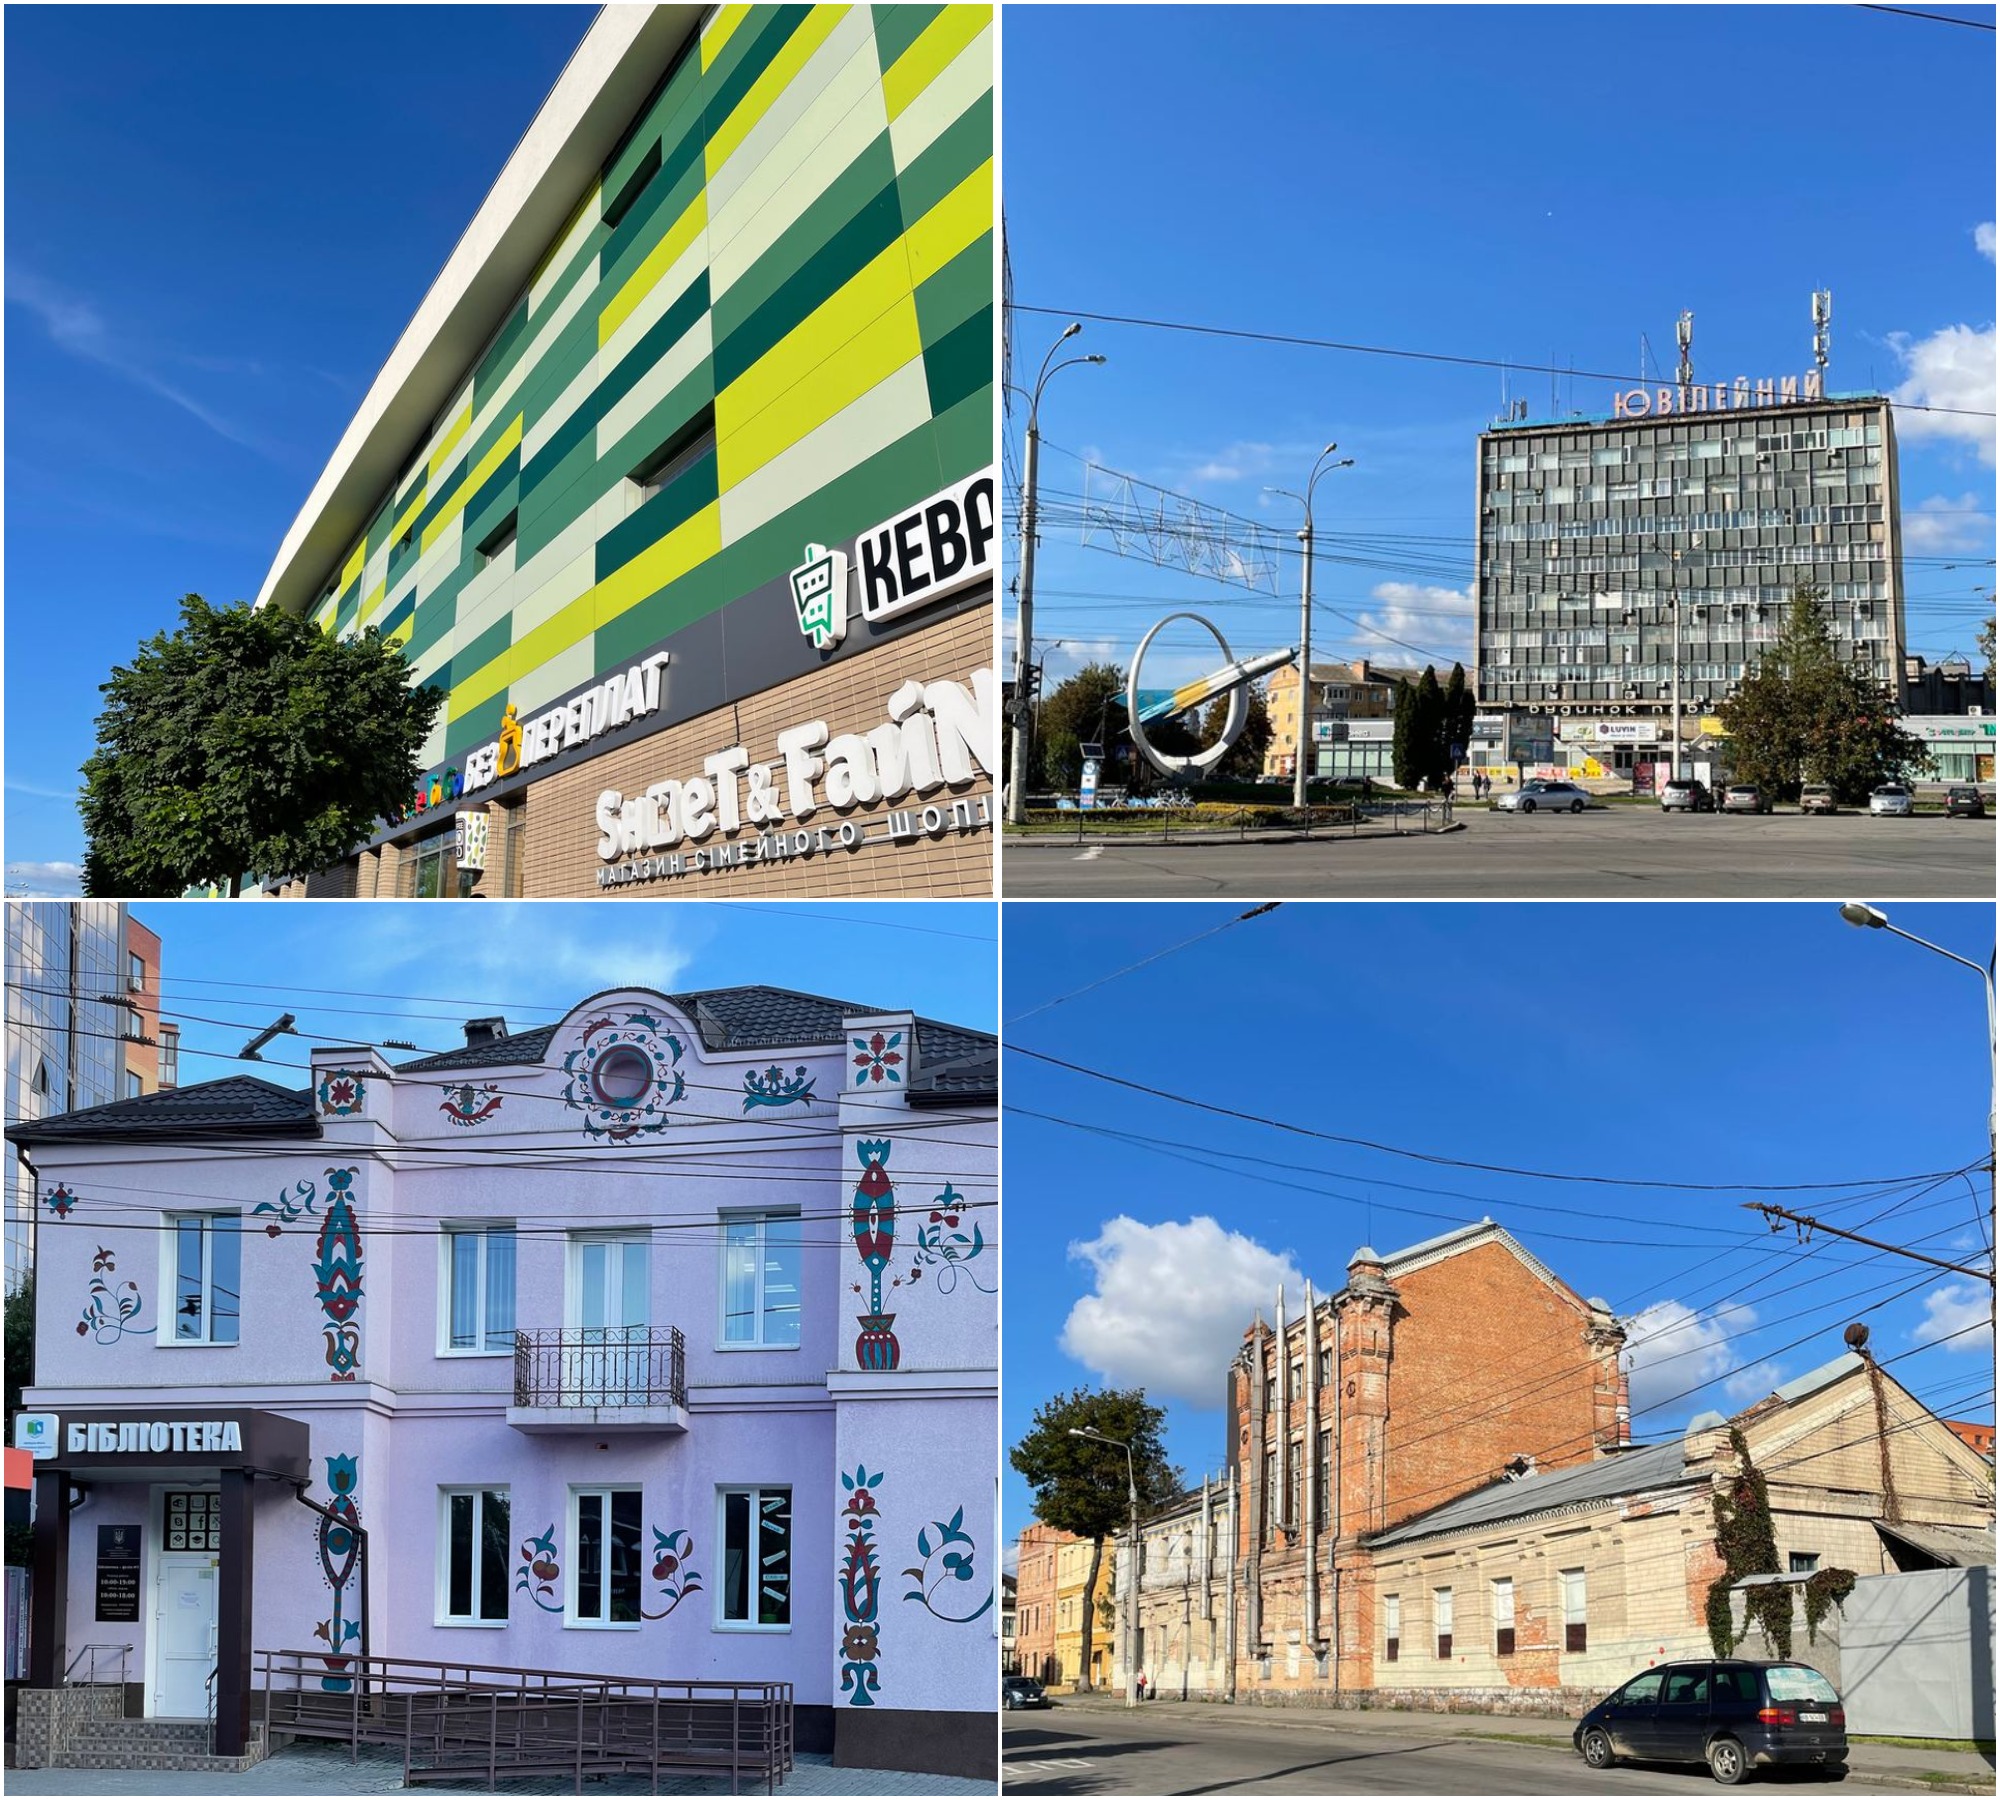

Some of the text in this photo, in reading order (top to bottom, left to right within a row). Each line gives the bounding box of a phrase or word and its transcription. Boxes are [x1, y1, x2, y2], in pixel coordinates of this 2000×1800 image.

[1614, 369, 1821, 419] ЮВІЛЕЙНИЙ
[462, 742, 501, 795] БЕЗ
[519, 651, 670, 769] ПЕРЕПЛАТ
[596, 853, 683, 886] МАГАЗИН
[694, 820, 864, 871] СІМЕЙНОГО
[67, 1421, 242, 1452] БІБЛІОТЕКА
